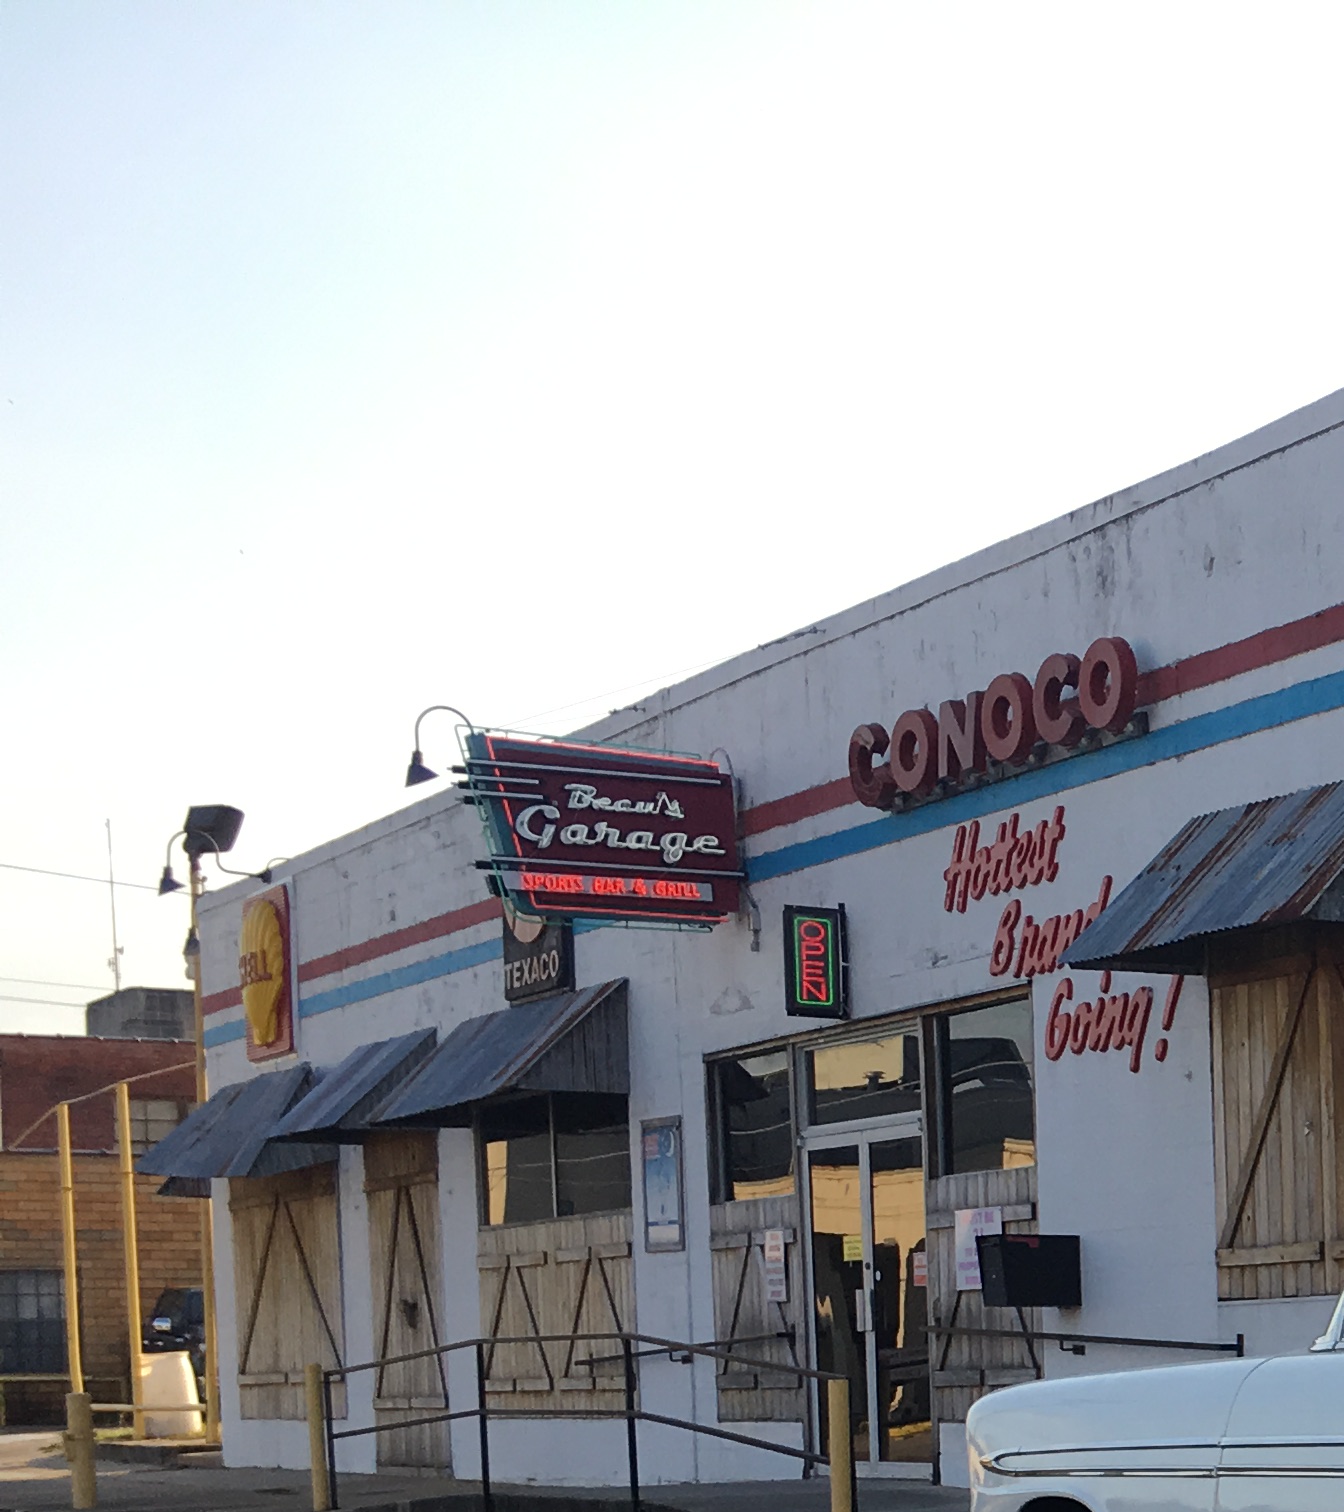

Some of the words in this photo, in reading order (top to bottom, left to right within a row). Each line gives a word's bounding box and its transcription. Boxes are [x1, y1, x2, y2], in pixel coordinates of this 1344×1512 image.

[849, 636, 1137, 811] CONOCO
[515, 803, 726, 864] Garage
[564, 782, 685, 819] Beau's
[520, 872, 584, 893] SPORTS
[592, 875, 626, 896] BAR
[631, 878, 647, 897] &
[652, 880, 701, 899] GRILL
[943, 805, 1066, 914] Hottest
[504, 949, 559, 990] TEXACO
[800, 920, 827, 1002] OPEN
[1044, 970, 1184, 1074] Going!
